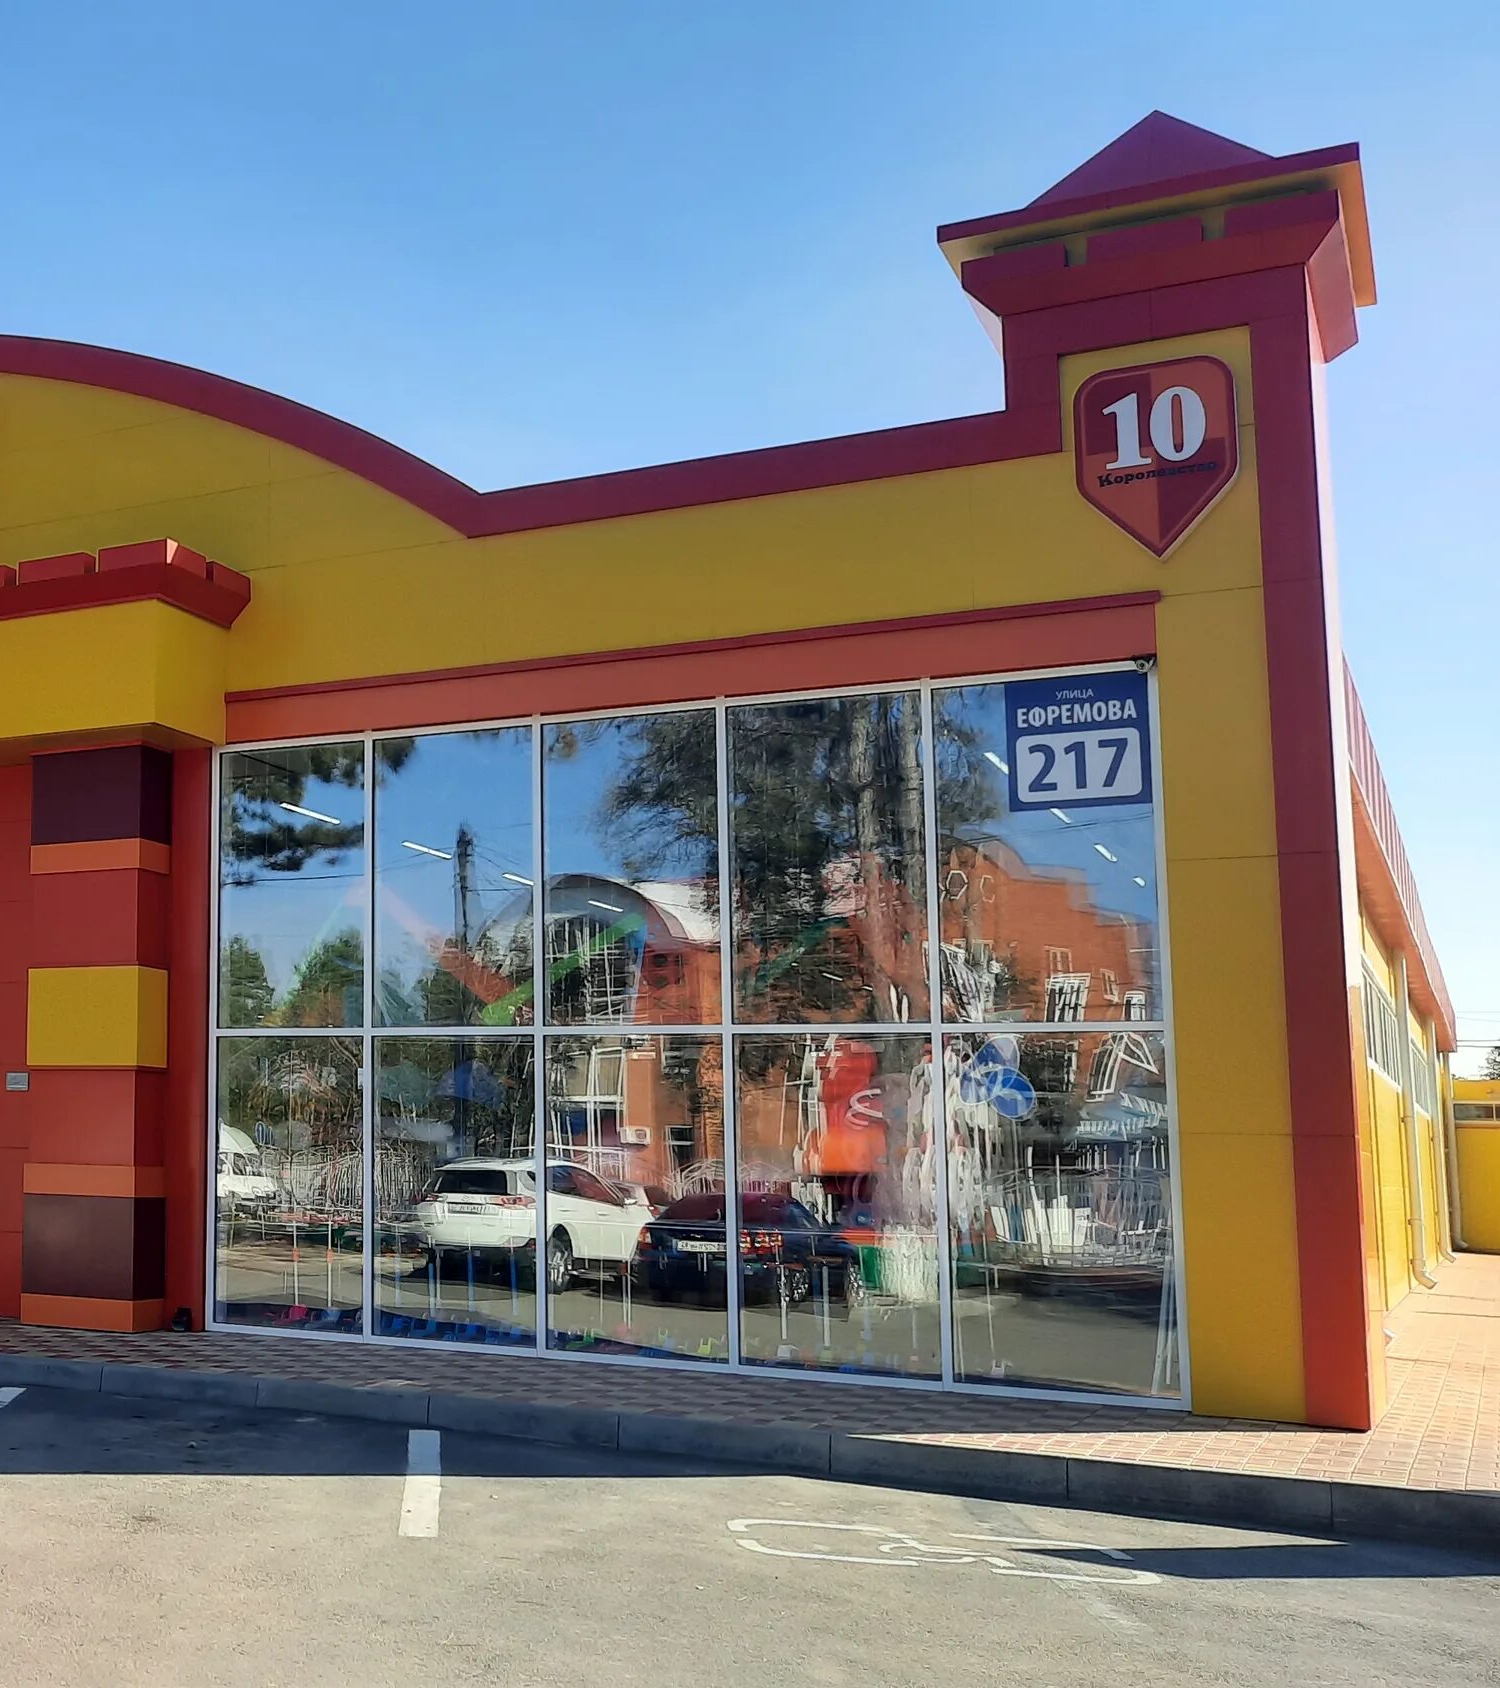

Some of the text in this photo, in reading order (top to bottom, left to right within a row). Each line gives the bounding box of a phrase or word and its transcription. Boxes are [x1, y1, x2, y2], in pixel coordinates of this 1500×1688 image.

[1102, 386, 1206, 470] 10
[1097, 461, 1217, 488] Королевство
[1055, 688, 1094, 700] УЛИЦА
[1016, 698, 1138, 729] ЕФРЕМОВА
[1027, 737, 1130, 793] 217
